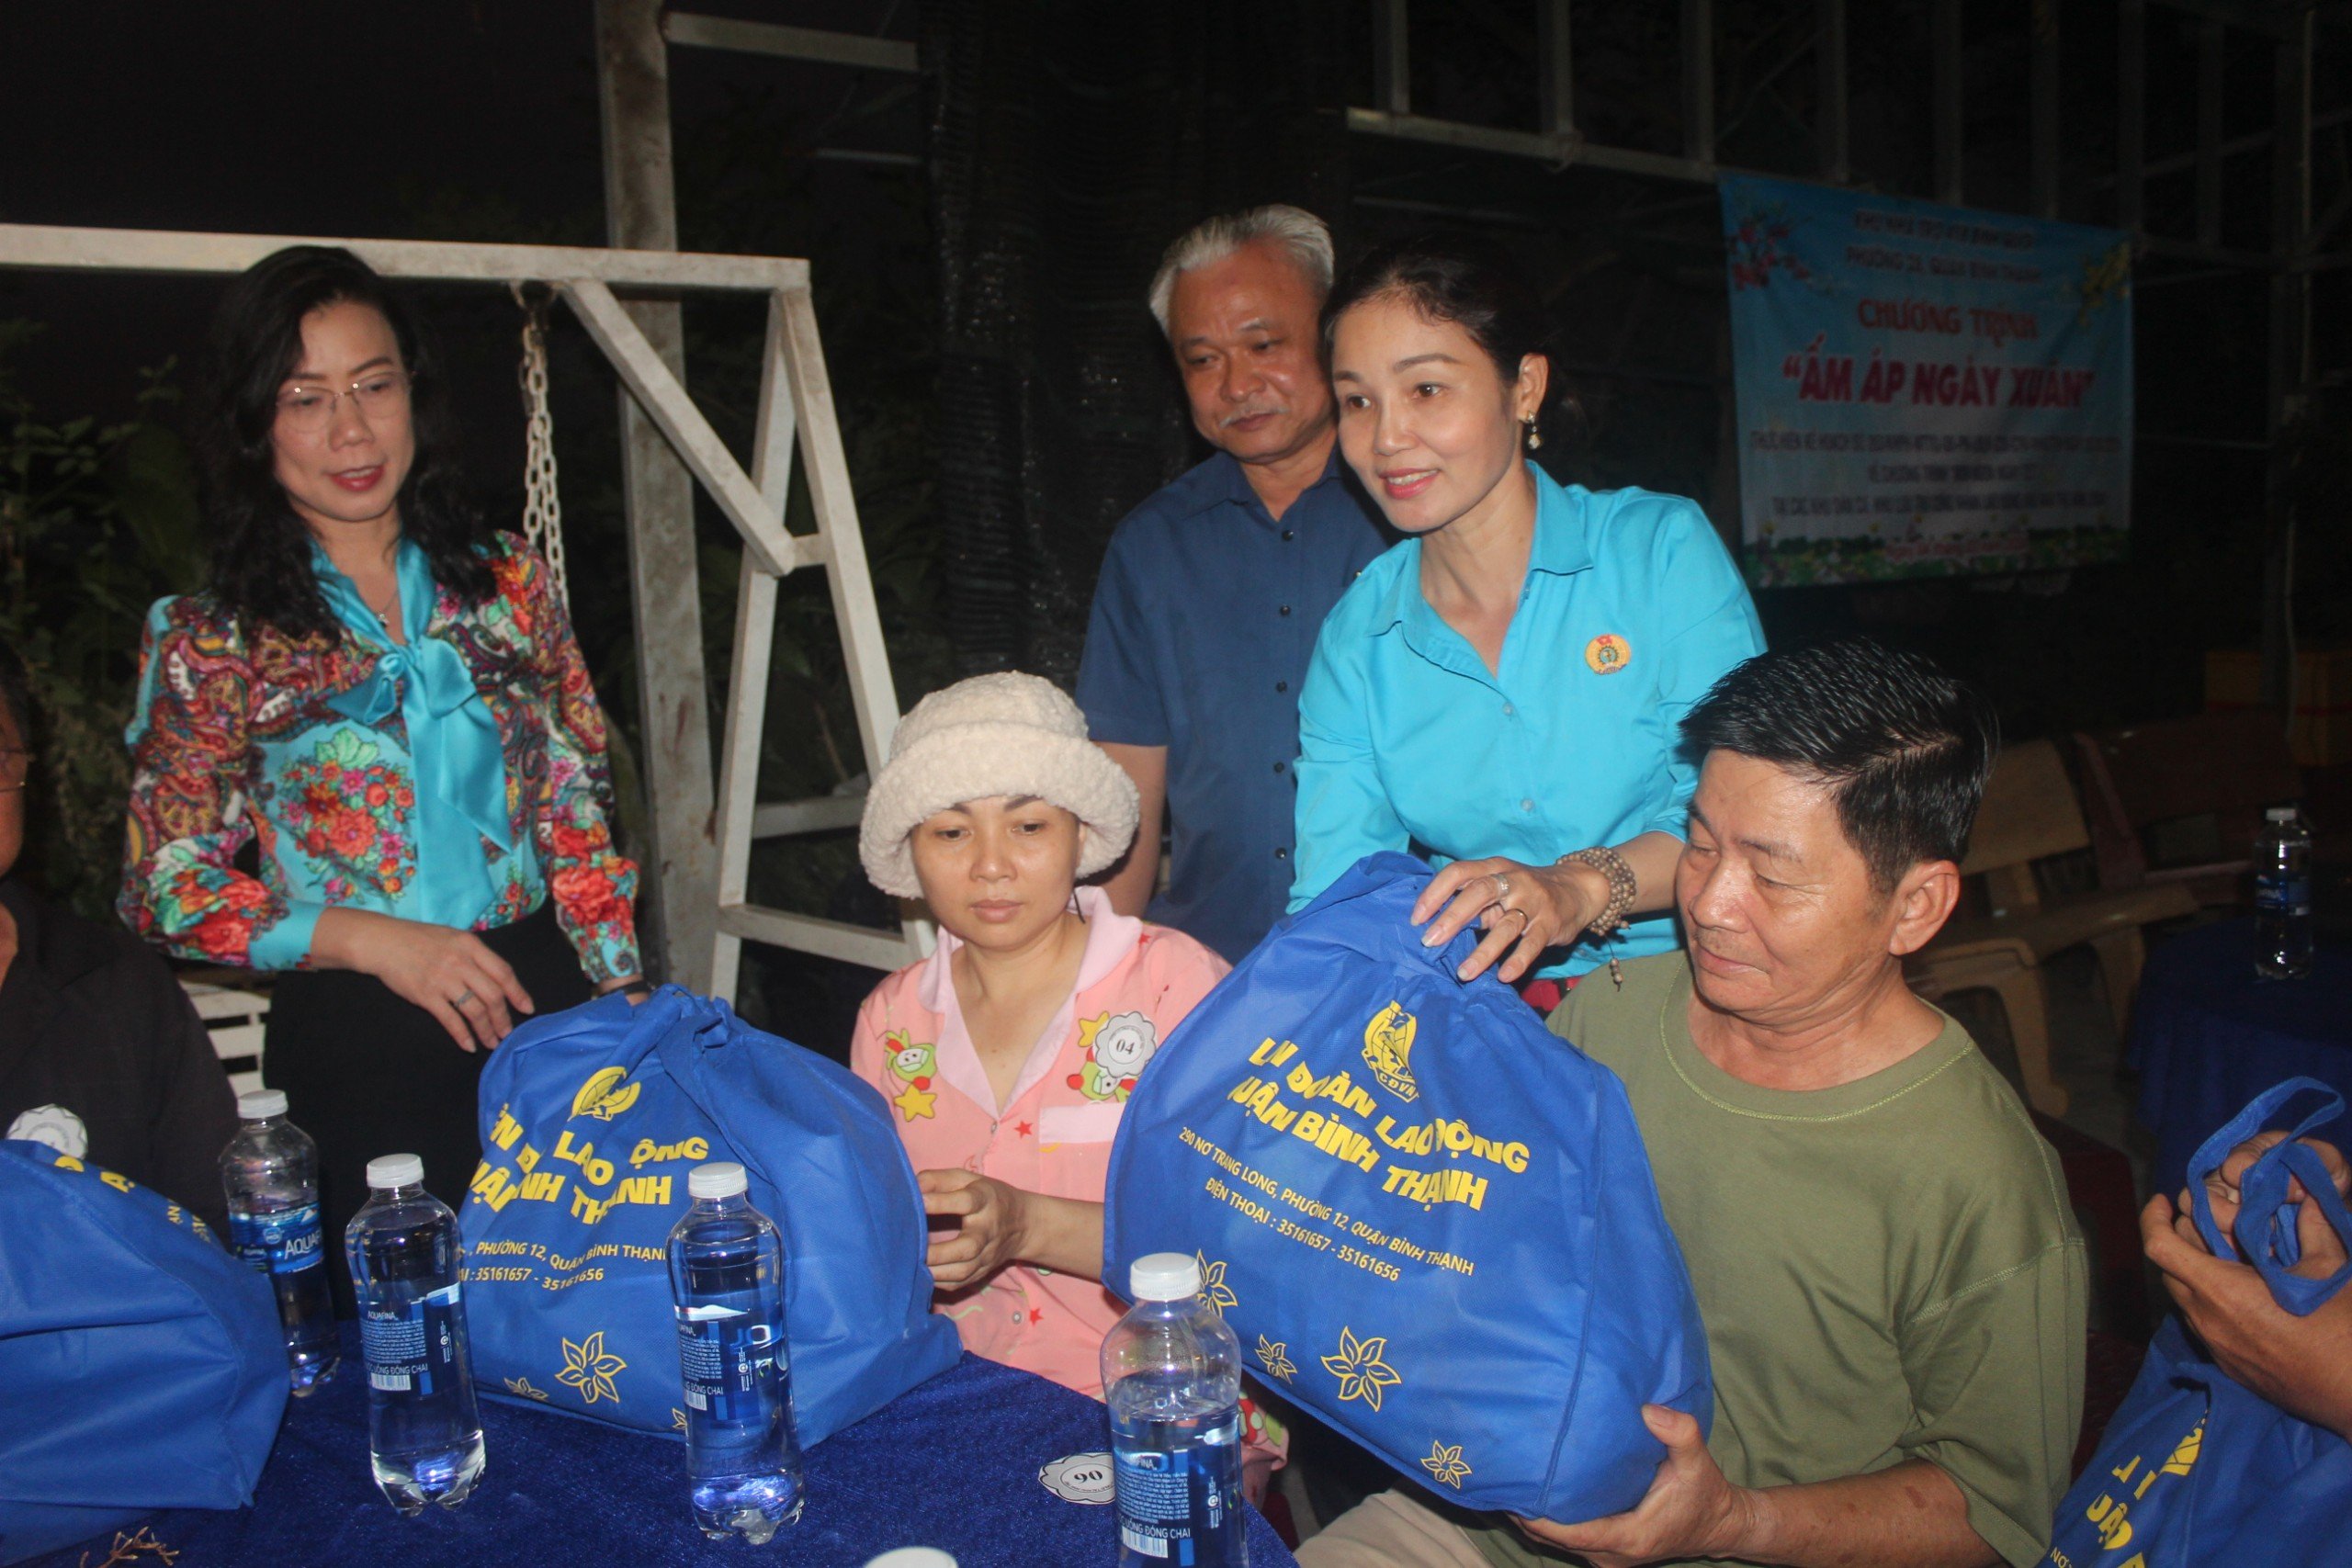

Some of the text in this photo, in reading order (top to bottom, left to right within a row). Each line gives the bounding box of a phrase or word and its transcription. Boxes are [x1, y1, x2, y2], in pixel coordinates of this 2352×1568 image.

[1859, 346, 1906, 404] ÁP
[1912, 355, 2001, 407] NGÀY
[1116, 1039, 1136, 1055] 04
[1227, 1077, 1488, 1212] UẬN BÌNH THẠNH
[1374, 1115, 1433, 1156] LAO
[628, 1135, 709, 1170] ỘNG
[1179, 1127, 1475, 1276] 290 NƠ TRANG LONG, PHƯỜNG 12, QUẬN BÌNH THẠNH
[1205, 1178, 1229, 1201] ĐIỆN
[1229, 1191, 1271, 1224] THOẠI
[1277, 1219, 1331, 1251] 35161657
[1337, 1245, 1401, 1281] 35161656
[476, 1239, 528, 1255] PHƯỜNG
[530, 1243, 547, 1262] 12,
[586, 1243, 618, 1261] BÌNH
[542, 1268, 604, 1291] 35161656
[412, 1362, 429, 1374] CHAI
[707, 1385, 724, 1395] CHAI
[1074, 1470, 1102, 1483] 90
[1145, 1524, 1168, 1539] ĐÓNG
[1170, 1528, 1191, 1539] CHAI
